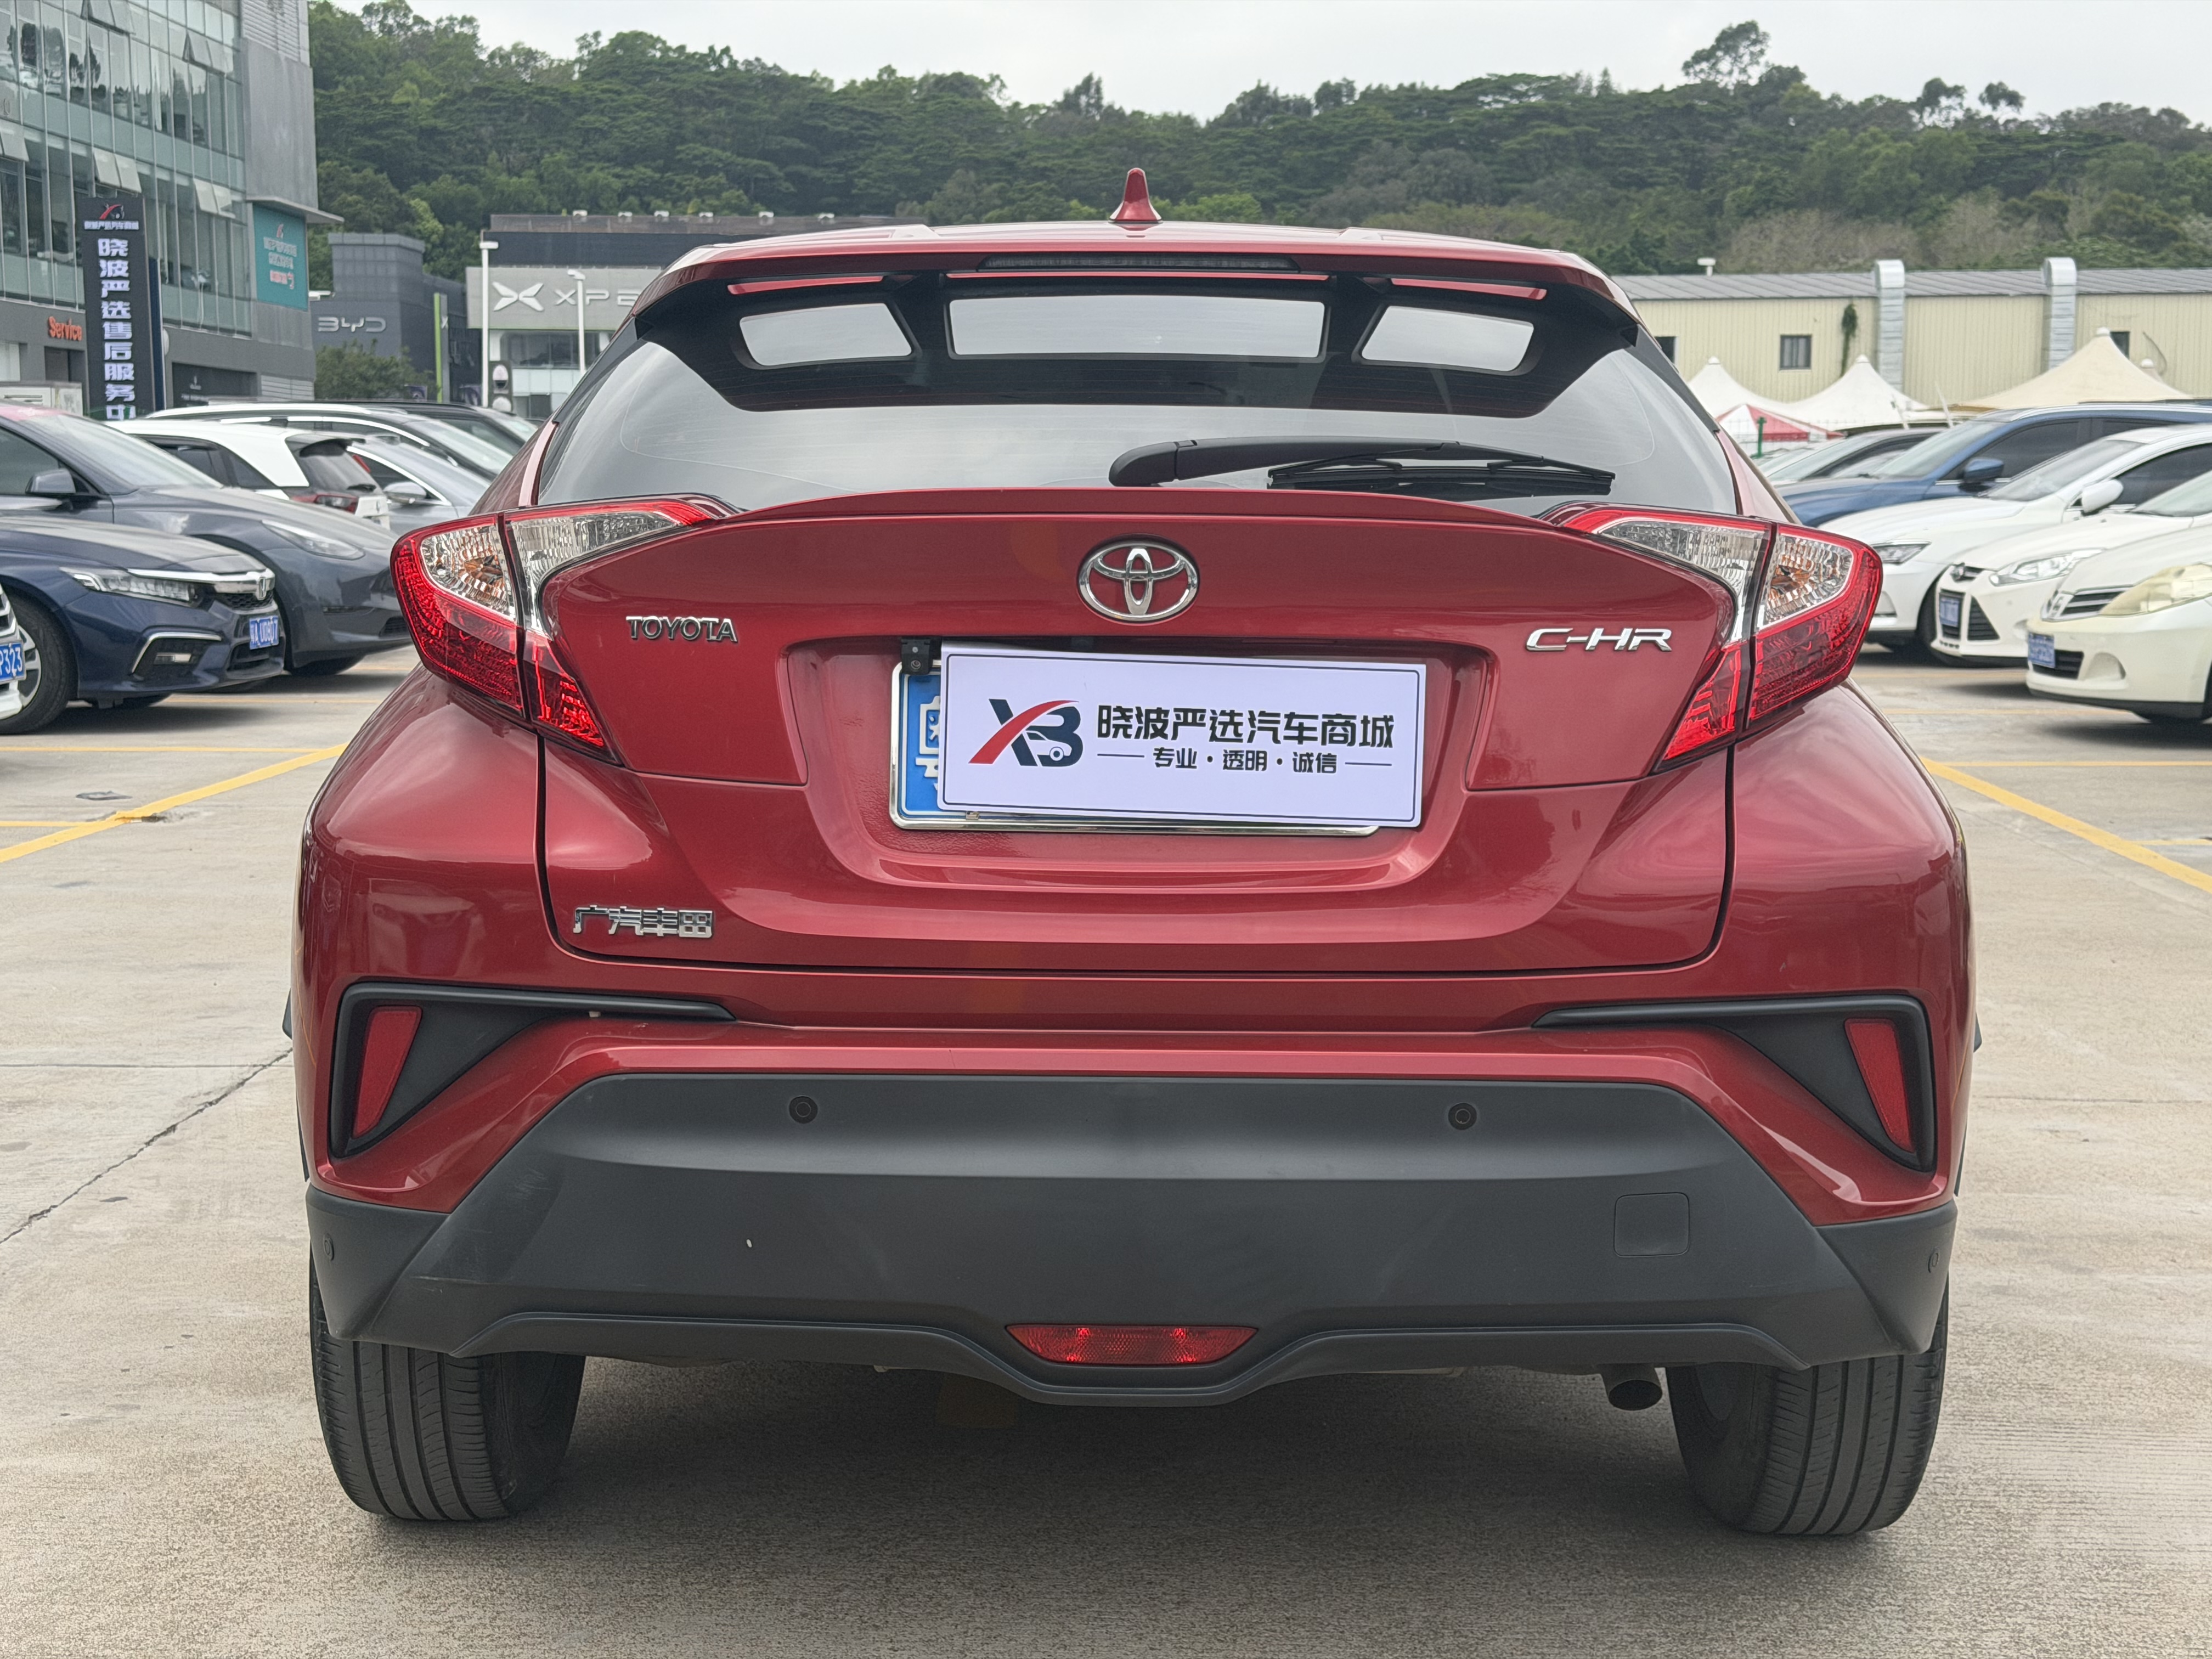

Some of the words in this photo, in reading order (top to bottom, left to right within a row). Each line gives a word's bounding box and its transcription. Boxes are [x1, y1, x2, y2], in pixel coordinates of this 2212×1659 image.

[48, 316, 82, 341] Service
[318, 317, 386, 333] BYD
[625, 616, 738, 643] TOYOTA
[1526, 628, 1672, 651] C-HR
[1097, 704, 1395, 748] 晓波严选汽车商城
[573, 905, 713, 938] 广汽丰田
